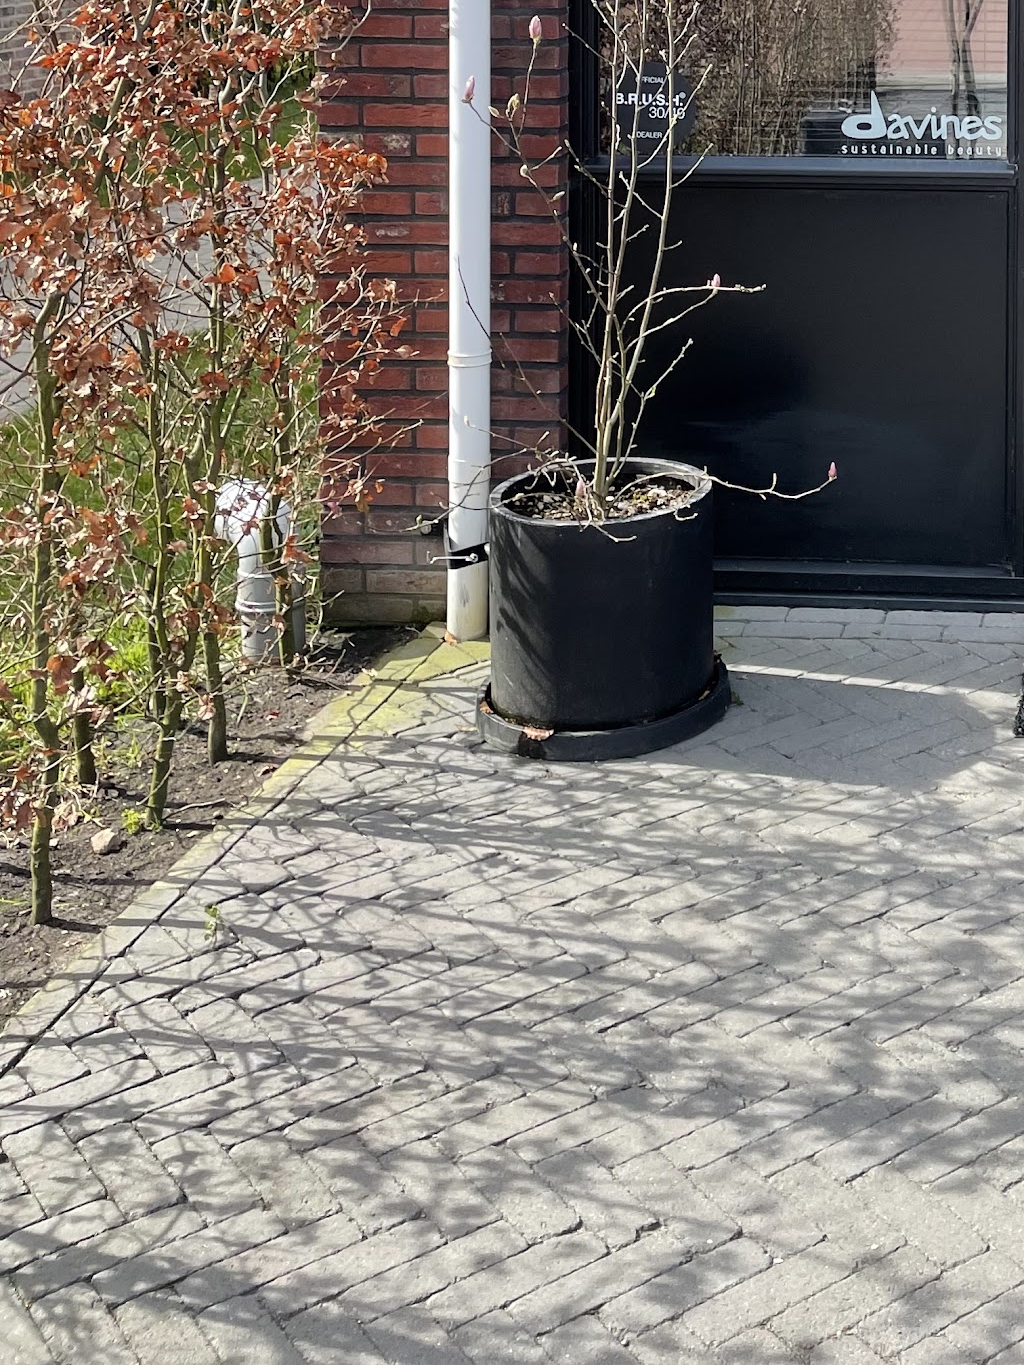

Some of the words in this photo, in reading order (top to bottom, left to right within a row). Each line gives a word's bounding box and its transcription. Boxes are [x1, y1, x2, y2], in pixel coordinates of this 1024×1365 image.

[841, 90, 1003, 141] davines
[636, 131, 663, 139] DEALER
[841, 143, 938, 156] sustainable
[947, 143, 1002, 157] beauty
